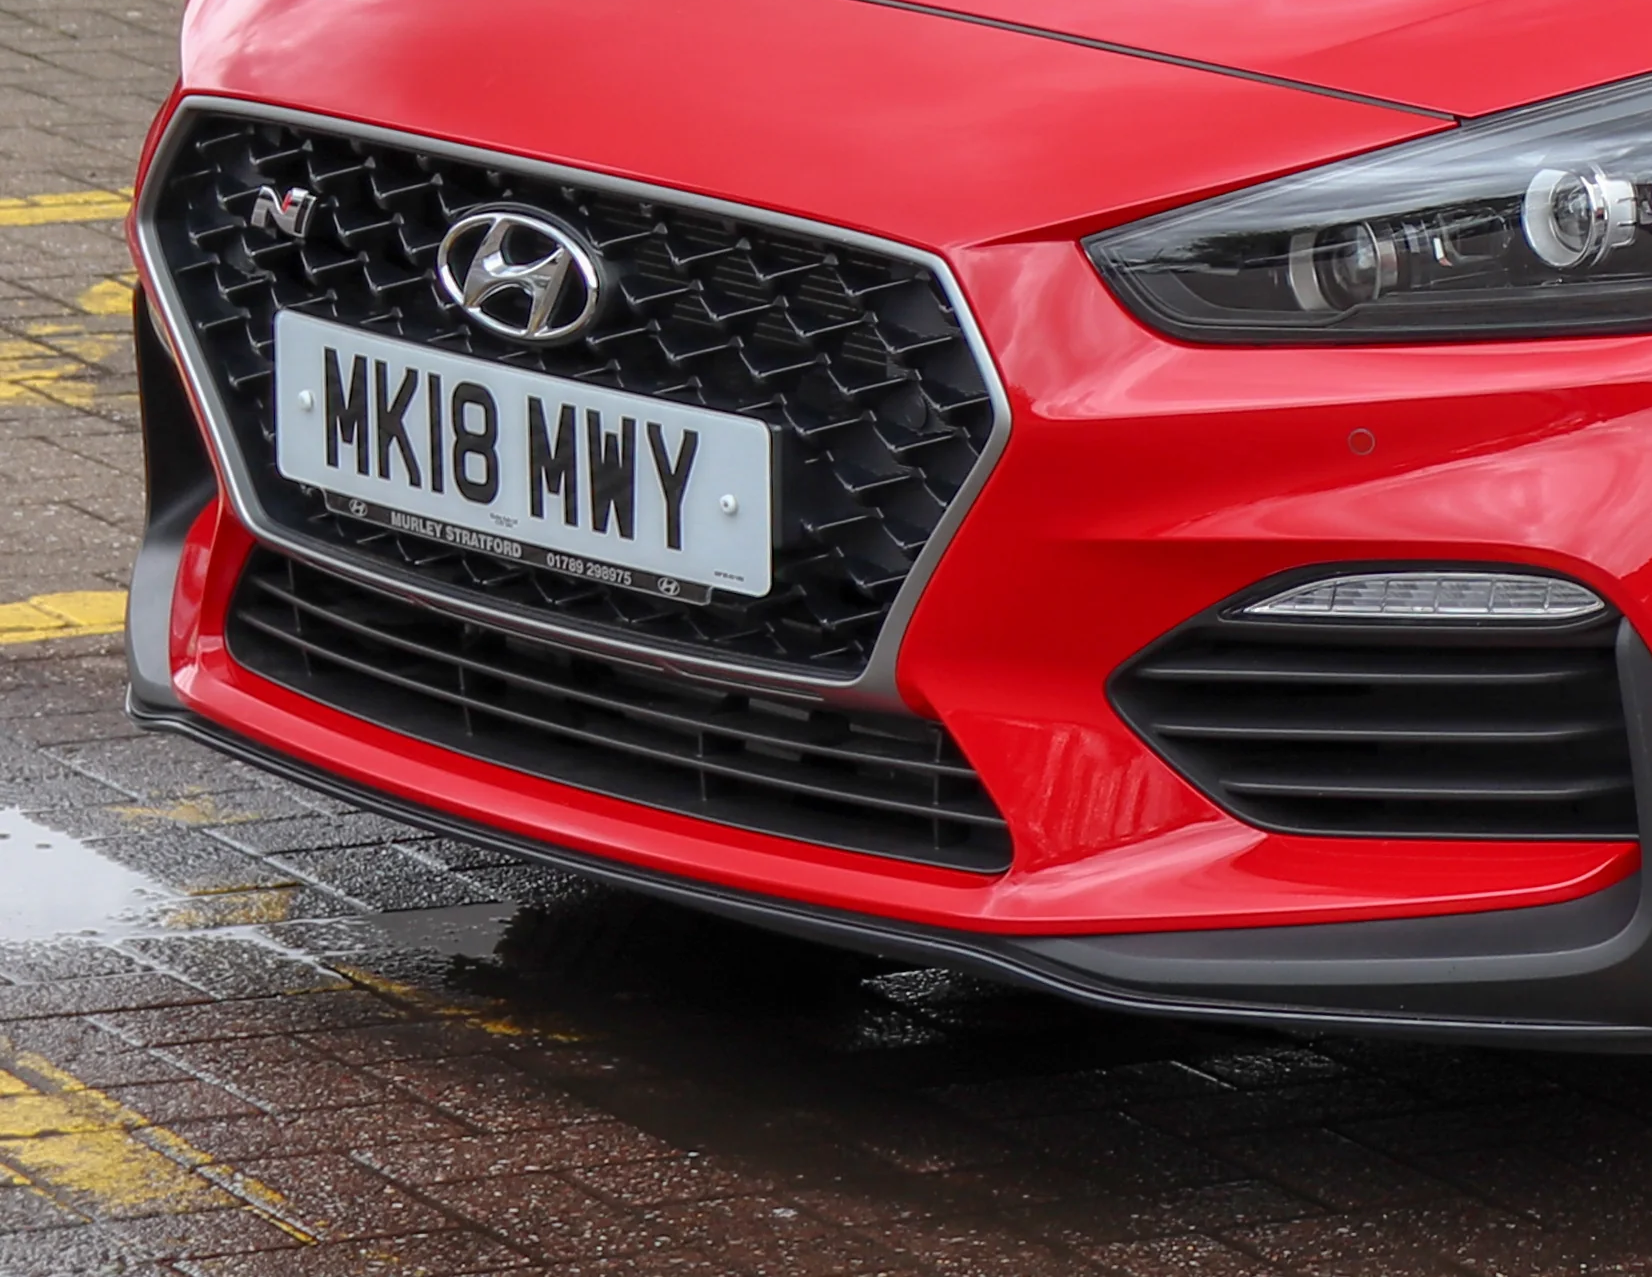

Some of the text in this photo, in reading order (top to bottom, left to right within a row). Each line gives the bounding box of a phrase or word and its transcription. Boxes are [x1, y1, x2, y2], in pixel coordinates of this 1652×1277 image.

[323, 346, 699, 551] MK18 MWY
[390, 510, 443, 539] MURLEY
[445, 524, 522, 559] STRATFORD
[546, 552, 583, 576] 01789
